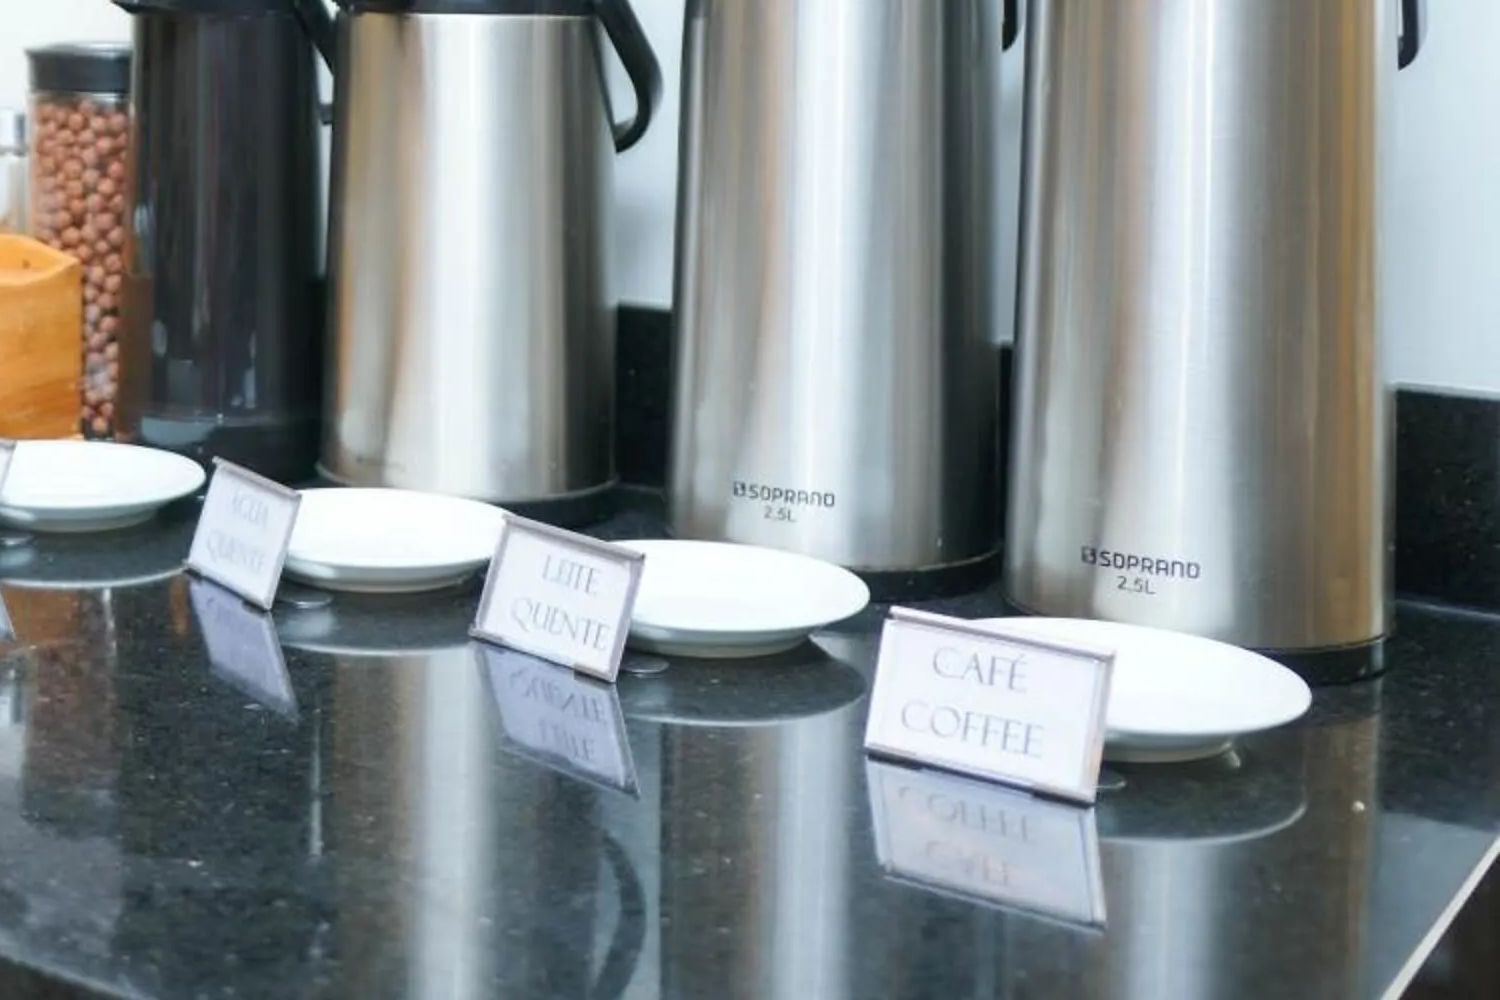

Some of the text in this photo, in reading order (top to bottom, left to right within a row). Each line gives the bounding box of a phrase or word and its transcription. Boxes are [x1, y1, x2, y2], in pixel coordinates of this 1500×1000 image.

[748, 483, 835, 508] SOPRANO
[541, 554, 603, 597] LEITE
[1098, 550, 1201, 580] SOPRANO
[510, 596, 612, 652] QUENTE
[931, 645, 1029, 694] CAFÉ
[901, 698, 1046, 760] COFFEE
